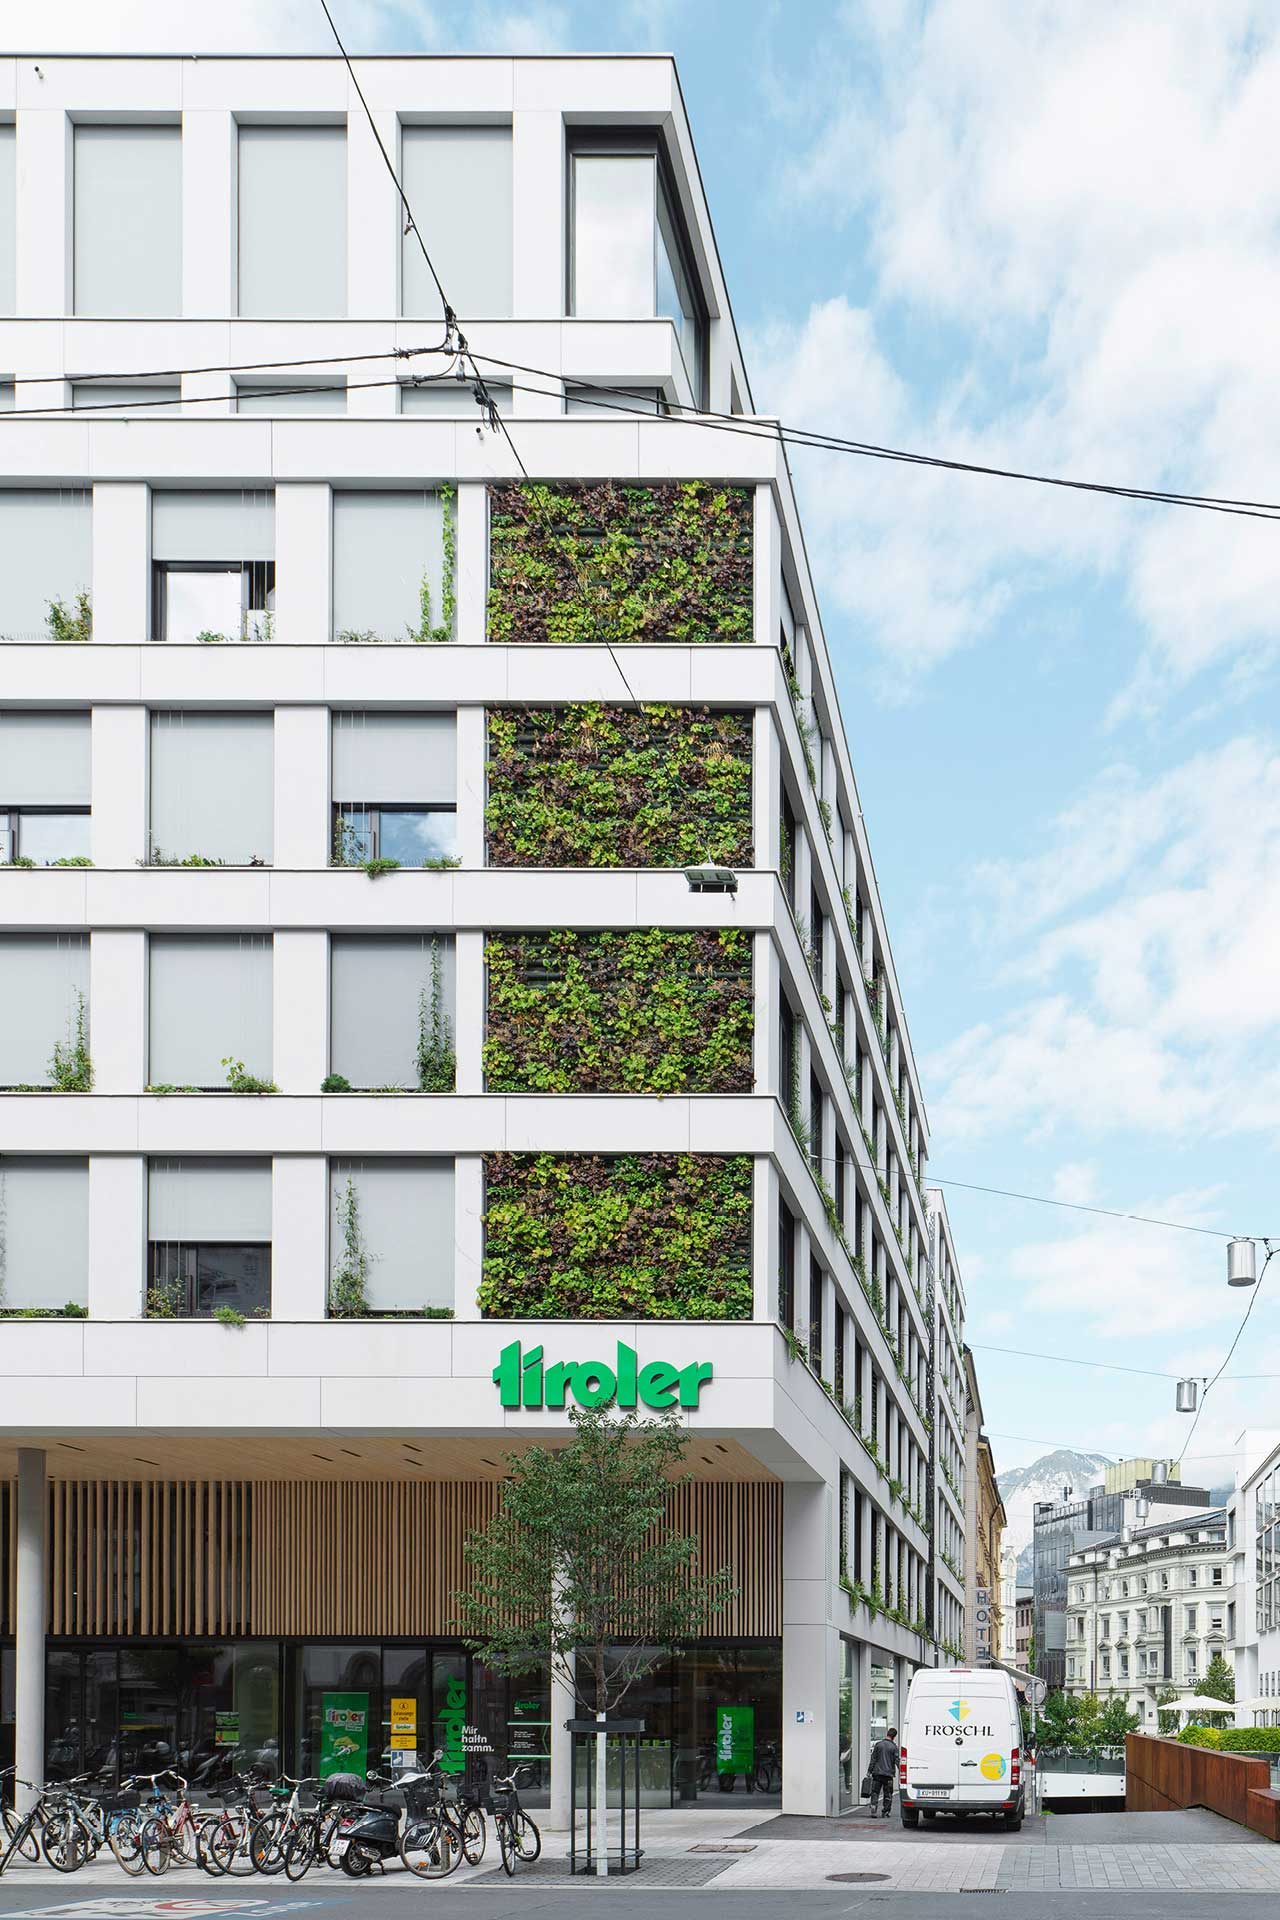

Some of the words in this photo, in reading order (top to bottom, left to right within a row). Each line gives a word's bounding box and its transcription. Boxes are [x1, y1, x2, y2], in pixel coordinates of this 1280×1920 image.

[492, 1339, 713, 1408] tiroler
[438, 1672, 466, 1775] tiroler
[461, 1726, 478, 1735] Mir
[719, 1713, 733, 1760] tiroler
[925, 1725, 995, 1737] FRÖSCHL
[461, 1744, 494, 1752] zamm.
